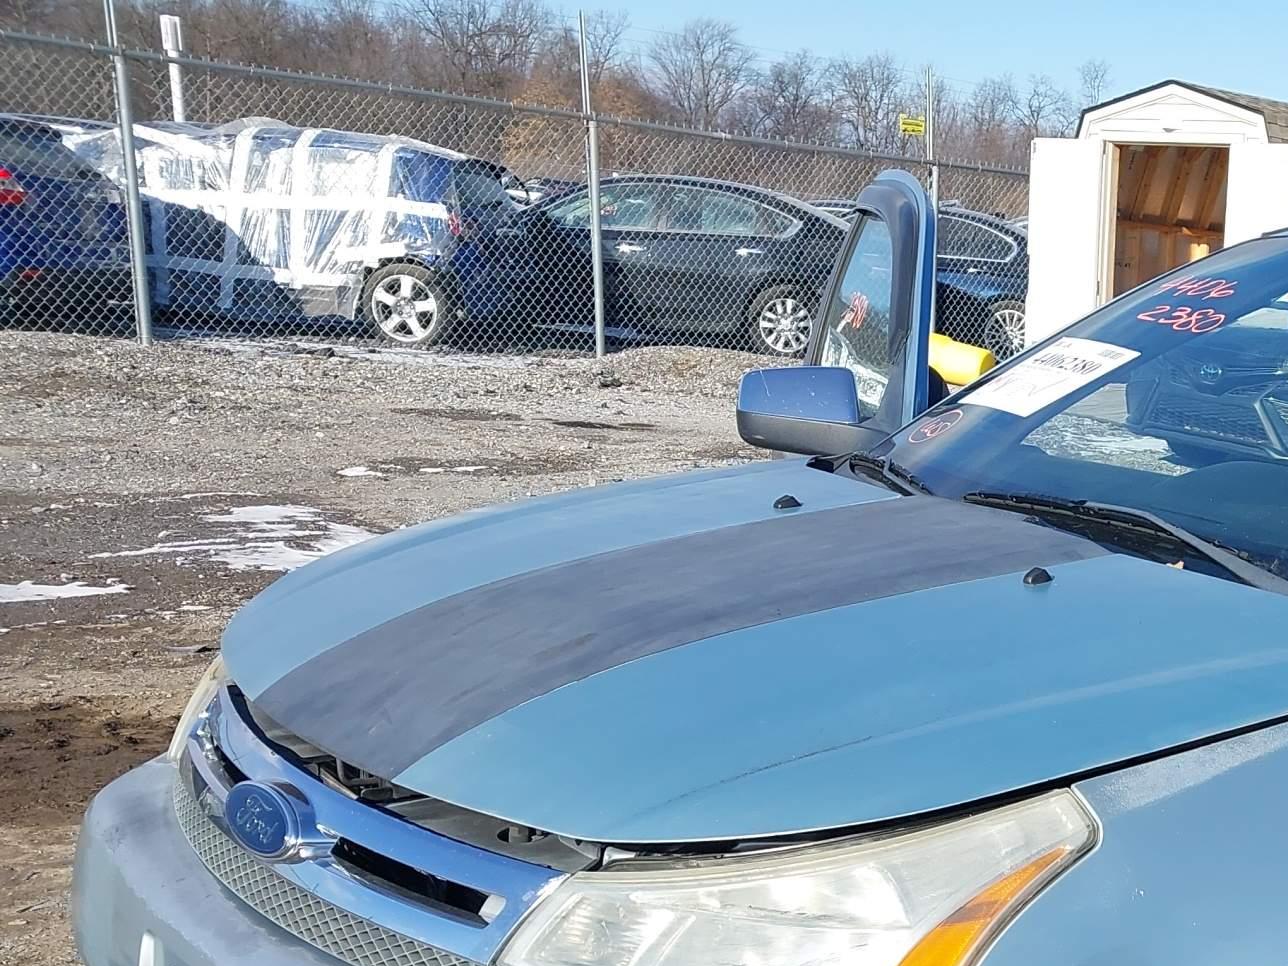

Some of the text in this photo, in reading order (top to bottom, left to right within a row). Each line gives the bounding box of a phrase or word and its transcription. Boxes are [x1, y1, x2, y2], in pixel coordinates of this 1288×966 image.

[1153, 275, 1238, 301] 4406
[1137, 305, 1225, 332] 2380
[236, 794, 279, 844] Ford
